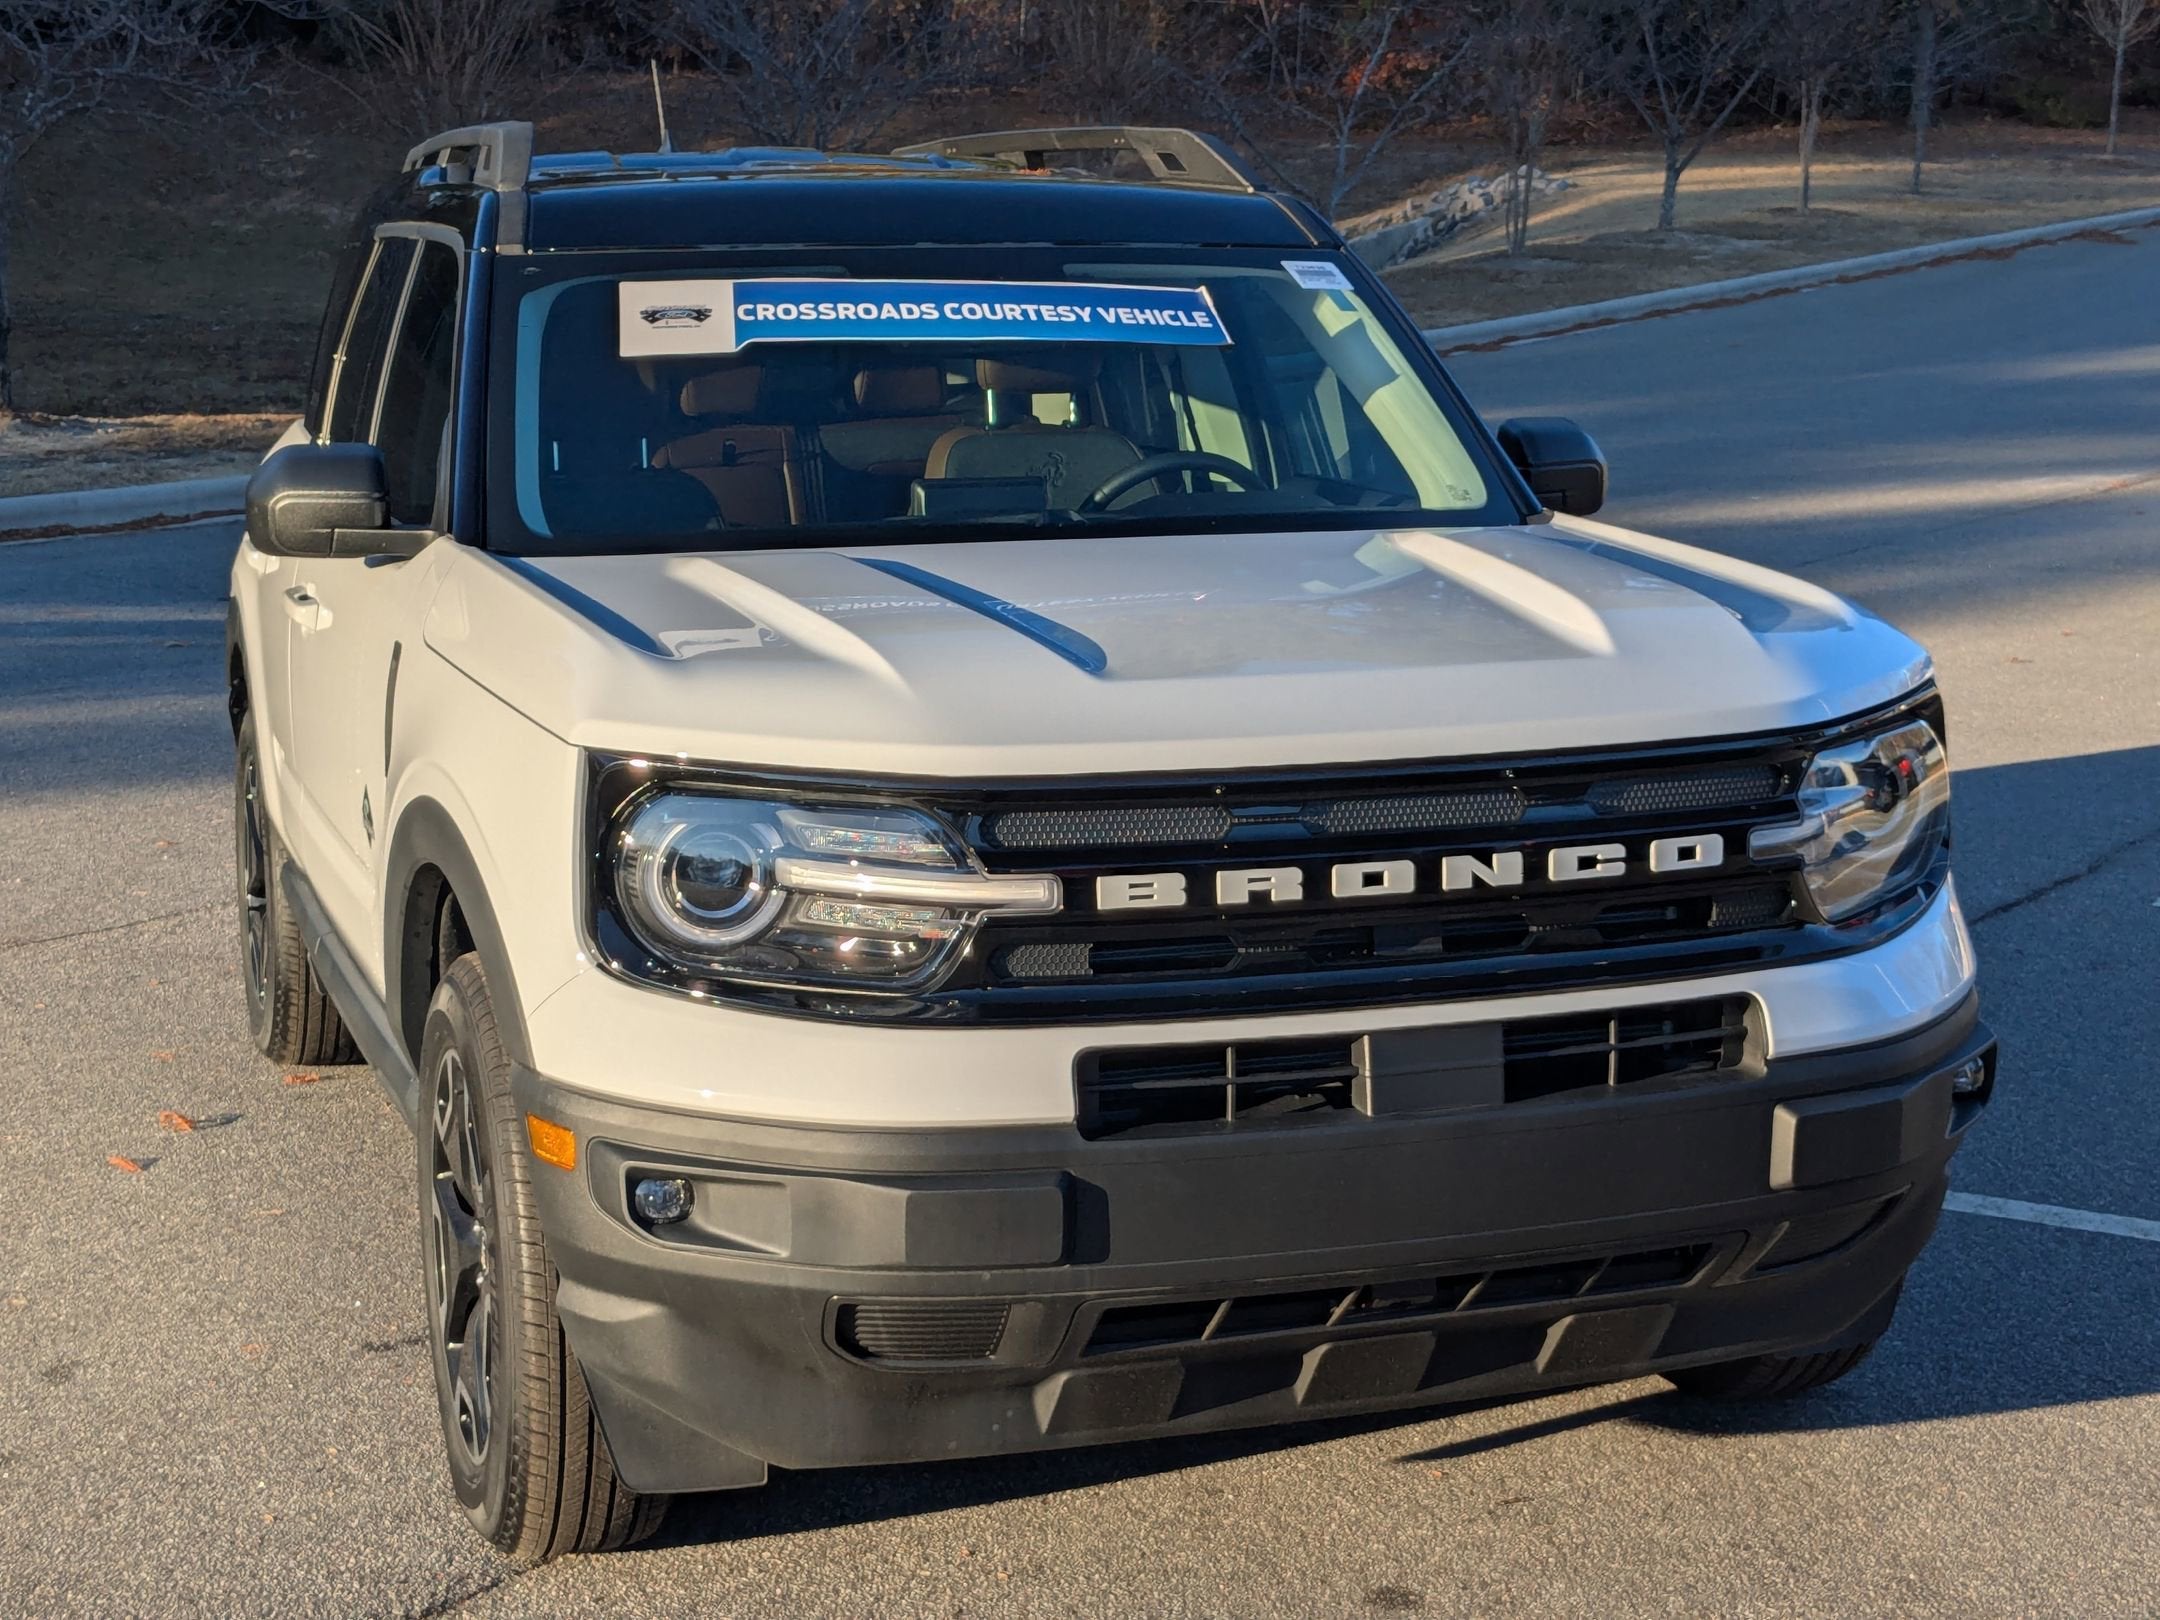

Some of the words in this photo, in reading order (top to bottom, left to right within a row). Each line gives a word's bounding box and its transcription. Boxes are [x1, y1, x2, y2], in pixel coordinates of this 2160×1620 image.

[736, 302, 940, 321] CROSSROADS
[943, 302, 1091, 323] COURTESY
[1096, 307, 1213, 328] VEHICLE
[1095, 834, 1724, 911] BRONCO
